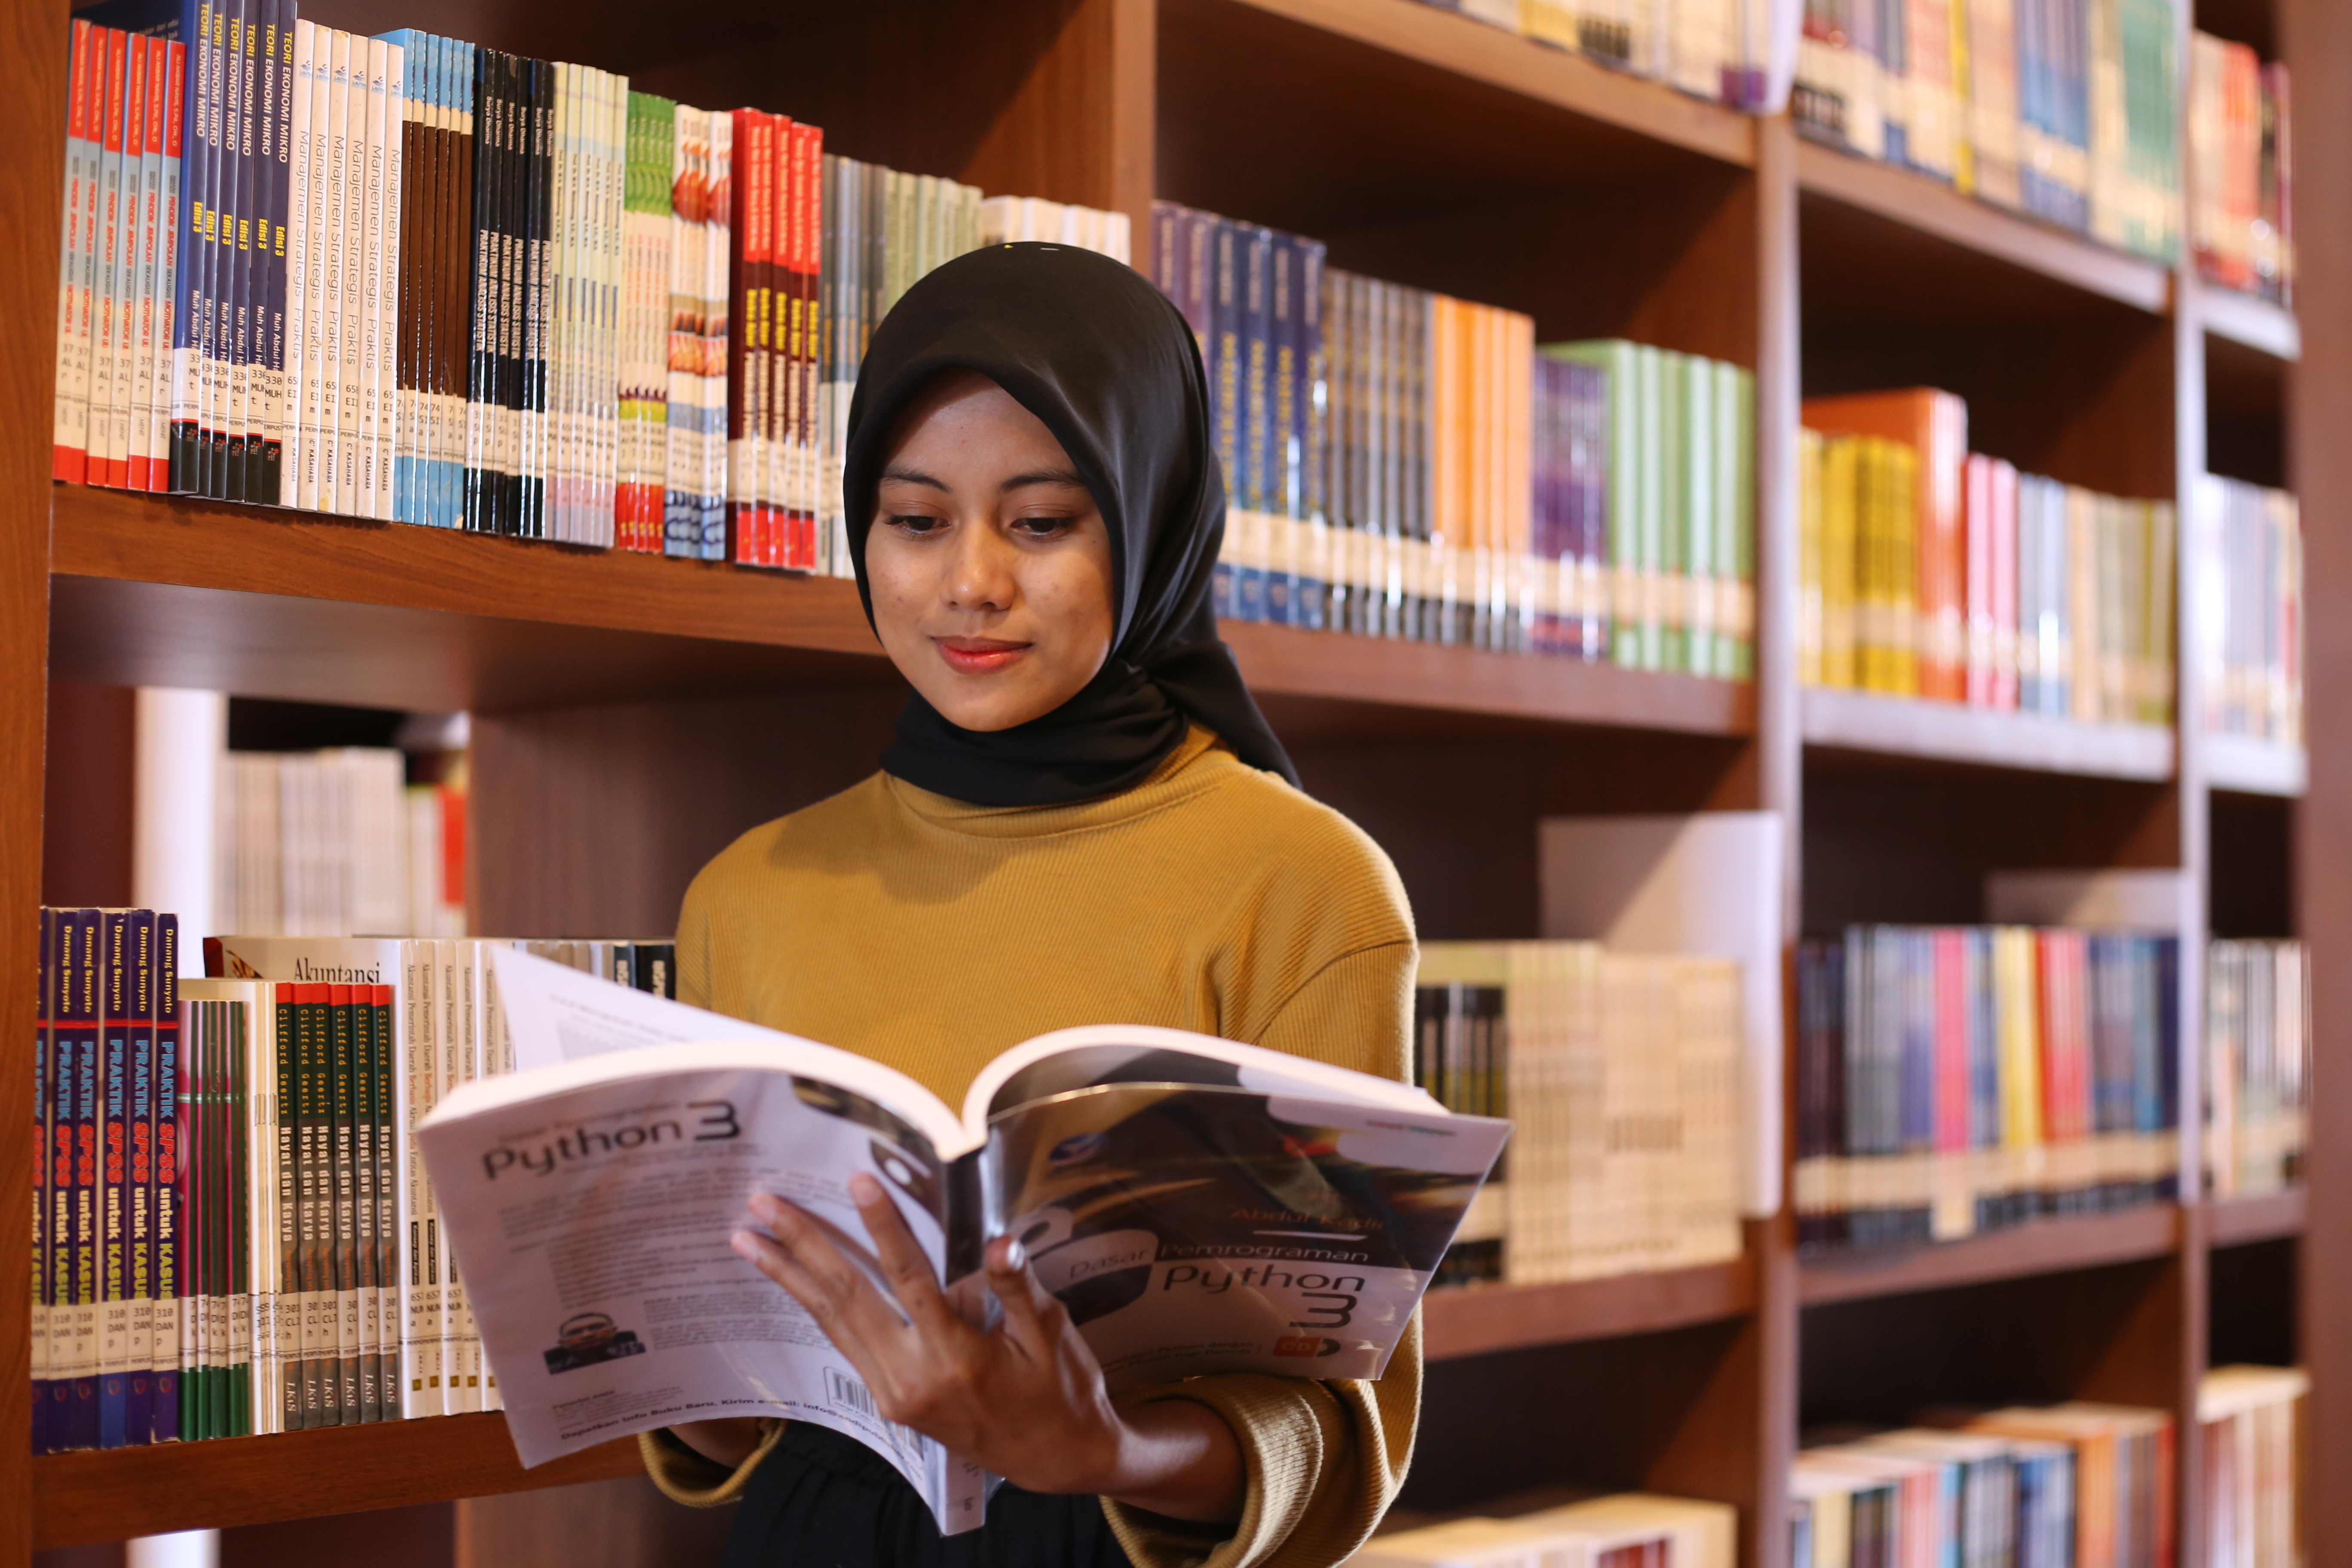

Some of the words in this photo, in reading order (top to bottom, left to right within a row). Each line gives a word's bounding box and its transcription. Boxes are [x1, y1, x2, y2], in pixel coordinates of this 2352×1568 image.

[200, 3, 209, 36] TEORI
[213, 13, 222, 46] TEORI
[230, 18, 239, 50] TEORI
[246, 24, 256, 57] TEORI
[266, 24, 275, 56] TEORI
[283, 32, 292, 64] TEORI
[198, 39, 208, 95] EKONOMI
[211, 49, 221, 104] EKONOMI
[228, 53, 238, 108] EKONOMI
[244, 59, 254, 114] EKONOMI
[263, 59, 273, 114] EKONOMI
[281, 67, 291, 122] EKONOMI
[196, 97, 206, 137] MIKRO
[209, 107, 219, 146] MIKRO
[226, 111, 236, 150] MIKRO
[242, 116, 252, 156] MIKRO
[262, 116, 272, 155] MIKRO
[279, 124, 288, 163] MIKRO
[297, 131, 309, 223] Manajemen
[313, 134, 326, 226] Manajemen
[331, 136, 344, 227] Manajemen
[349, 140, 363, 231] Manajemen
[368, 145, 382, 236] Manajemen
[387, 150, 400, 239] Manajemen
[193, 201, 203, 224] Edisi
[206, 210, 215, 233] Edisi
[223, 214, 233, 238] Edisi
[239, 219, 248, 242] Edisi
[258, 218, 268, 242] Edisi
[276, 226, 285, 249] Edisi
[294, 229, 306, 297] Strategis
[310, 231, 323, 299] Strategis
[328, 232, 341, 300] Strategis
[346, 237, 360, 304] Strategis
[366, 241, 379, 308] Strategis
[384, 245, 397, 311] Strategis
[220, 323, 228, 349] Abdul
[273, 333, 281, 360] Abdul
[293, 308, 303, 358] Praktis
[310, 310, 321, 361] Praktis
[328, 311, 339, 361] Praktis
[347, 314, 358, 364] Praktis
[366, 318, 377, 369] Praktis
[384, 321, 395, 371] Praktis
[265, 376, 282, 385] 330
[265, 389, 282, 398] MUH
[112, 925, 123, 965] Danang
[138, 926, 148, 966] Danang
[164, 929, 174, 968] Danang
[112, 968, 122, 1011] Sunyoto
[138, 969, 147, 1011] Sunyoto
[294, 957, 380, 983] Akuntansi
[163, 971, 173, 1013] Sunyoto
[279, 1009, 288, 1064] Clifford
[300, 1009, 309, 1064] Clifford
[316, 1009, 326, 1064] Clifford
[337, 1010, 346, 1066] Clifford
[358, 1008, 368, 1063] Clifford
[378, 1011, 388, 1066] Clifford
[109, 1040, 123, 1117] PRAKTIK
[135, 1040, 148, 1118] PRAKTIK
[160, 1041, 174, 1118] PRAKTIK
[280, 1074, 289, 1114] Geertz
[301, 1073, 310, 1114] Geertz
[317, 1073, 326, 1113] Geertz
[338, 1074, 347, 1115] Geertz
[358, 1072, 368, 1112] Geertz
[380, 1073, 388, 1114] Geertz
[107, 1121, 123, 1183] SPSS
[133, 1122, 149, 1183] SPSS
[159, 1123, 175, 1184] SPSS
[280, 1127, 292, 1166] Hayat
[301, 1126, 313, 1165] Hayat
[317, 1126, 329, 1164] Hayat
[338, 1126, 351, 1165] Hayat
[358, 1124, 371, 1163] Hayat
[380, 1125, 391, 1164] Hayat
[281, 1172, 293, 1196] dan
[303, 1171, 313, 1195] dan
[318, 1170, 330, 1194] dan
[340, 1170, 352, 1195] dan
[360, 1168, 371, 1193] dan
[381, 1169, 392, 1194] dan
[108, 1188, 122, 1240] untuk
[134, 1187, 147, 1239] untuk
[159, 1188, 173, 1240] untuk
[281, 1202, 293, 1242] Karya
[303, 1201, 314, 1240] Karya
[318, 1200, 331, 1239] Karya
[340, 1201, 352, 1240] Karya
[360, 1198, 372, 1237] Karya
[381, 1200, 392, 1238] Karya
[108, 1243, 122, 1301] KASUS
[134, 1243, 147, 1299] KASUS
[159, 1243, 173, 1300] KASUS
[1069, 1249, 1147, 1280] Dasar
[1161, 1244, 1369, 1263] Pemrograman
[156, 1308, 174, 1318] 310
[156, 1322, 174, 1331] DAN
